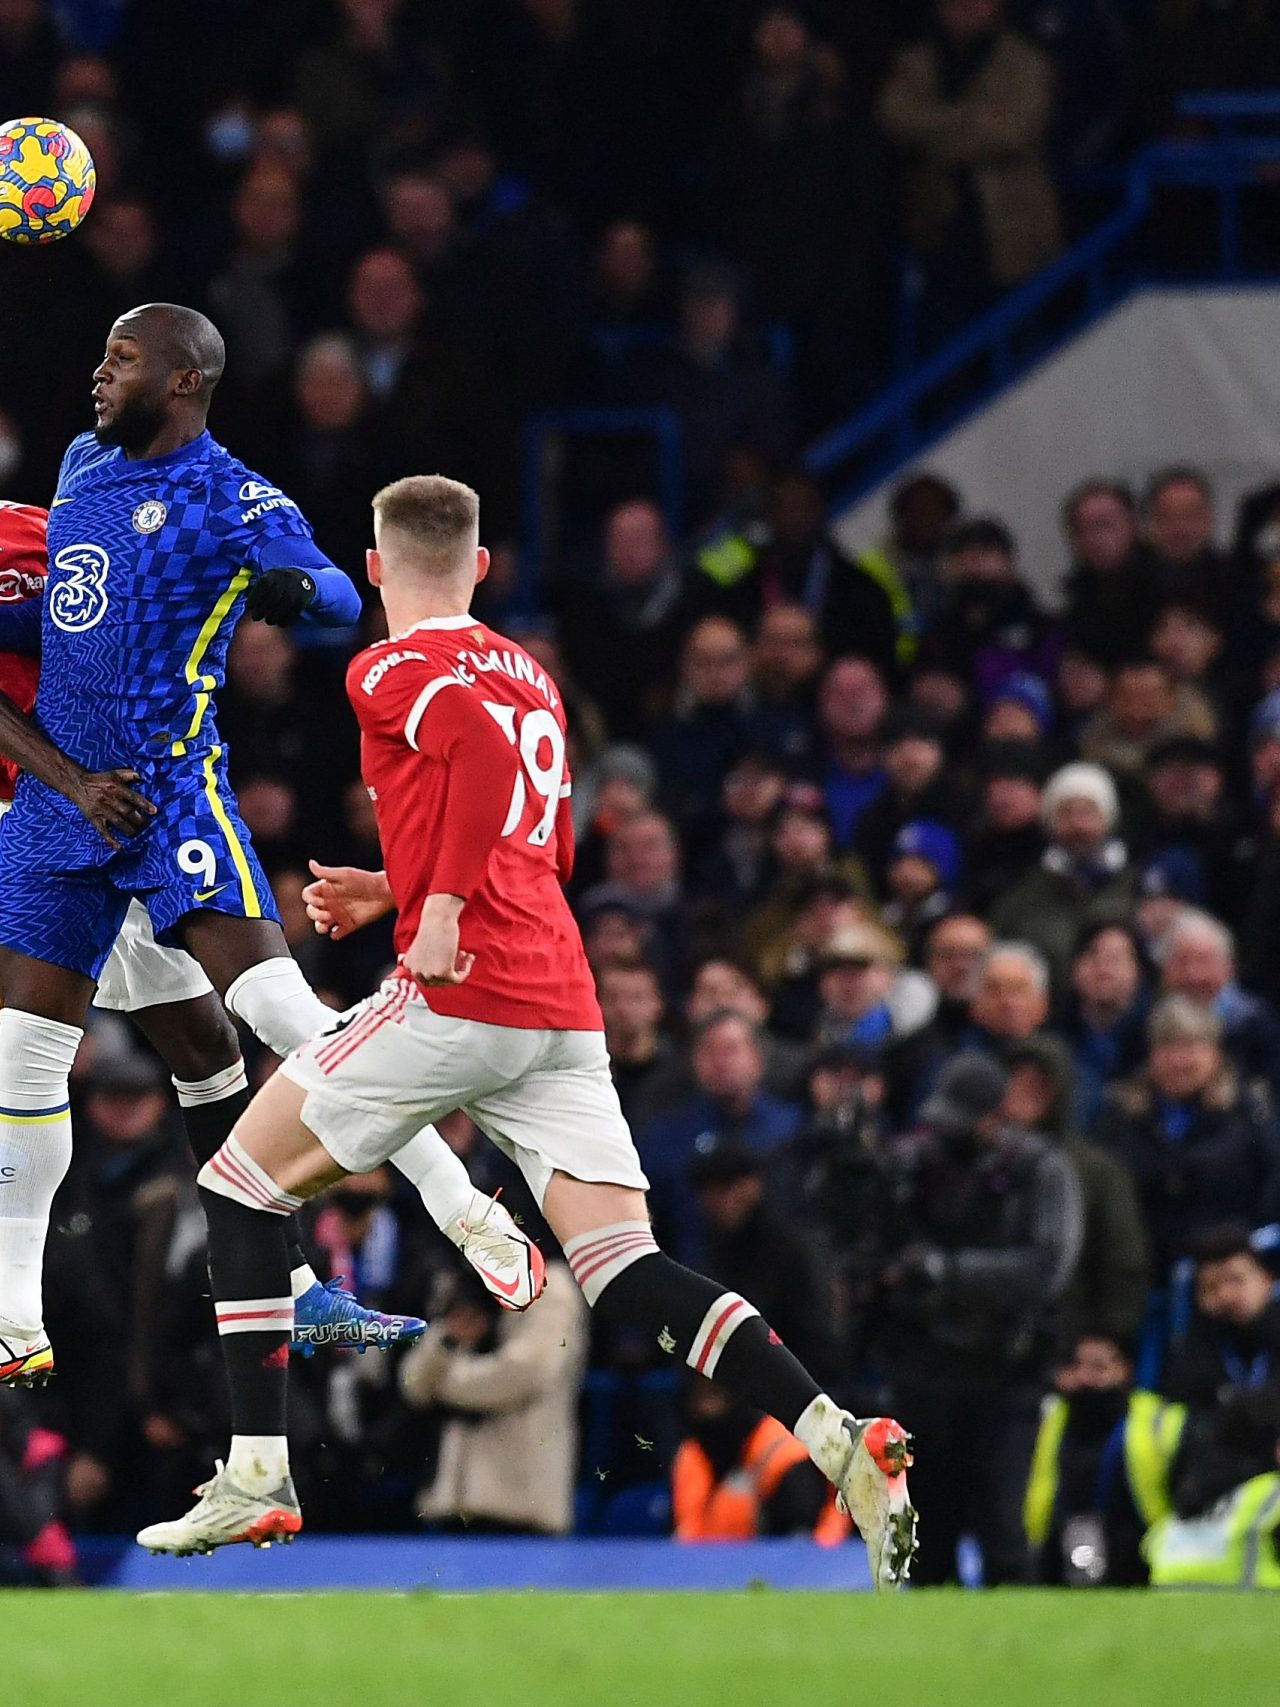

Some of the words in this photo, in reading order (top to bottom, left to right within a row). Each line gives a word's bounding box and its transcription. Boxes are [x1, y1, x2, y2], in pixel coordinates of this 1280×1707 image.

[241, 498, 297, 524] HYUND
[480, 699, 565, 847] 19
[177, 839, 216, 888] 9
[293, 1319, 404, 1345] FUTURE
